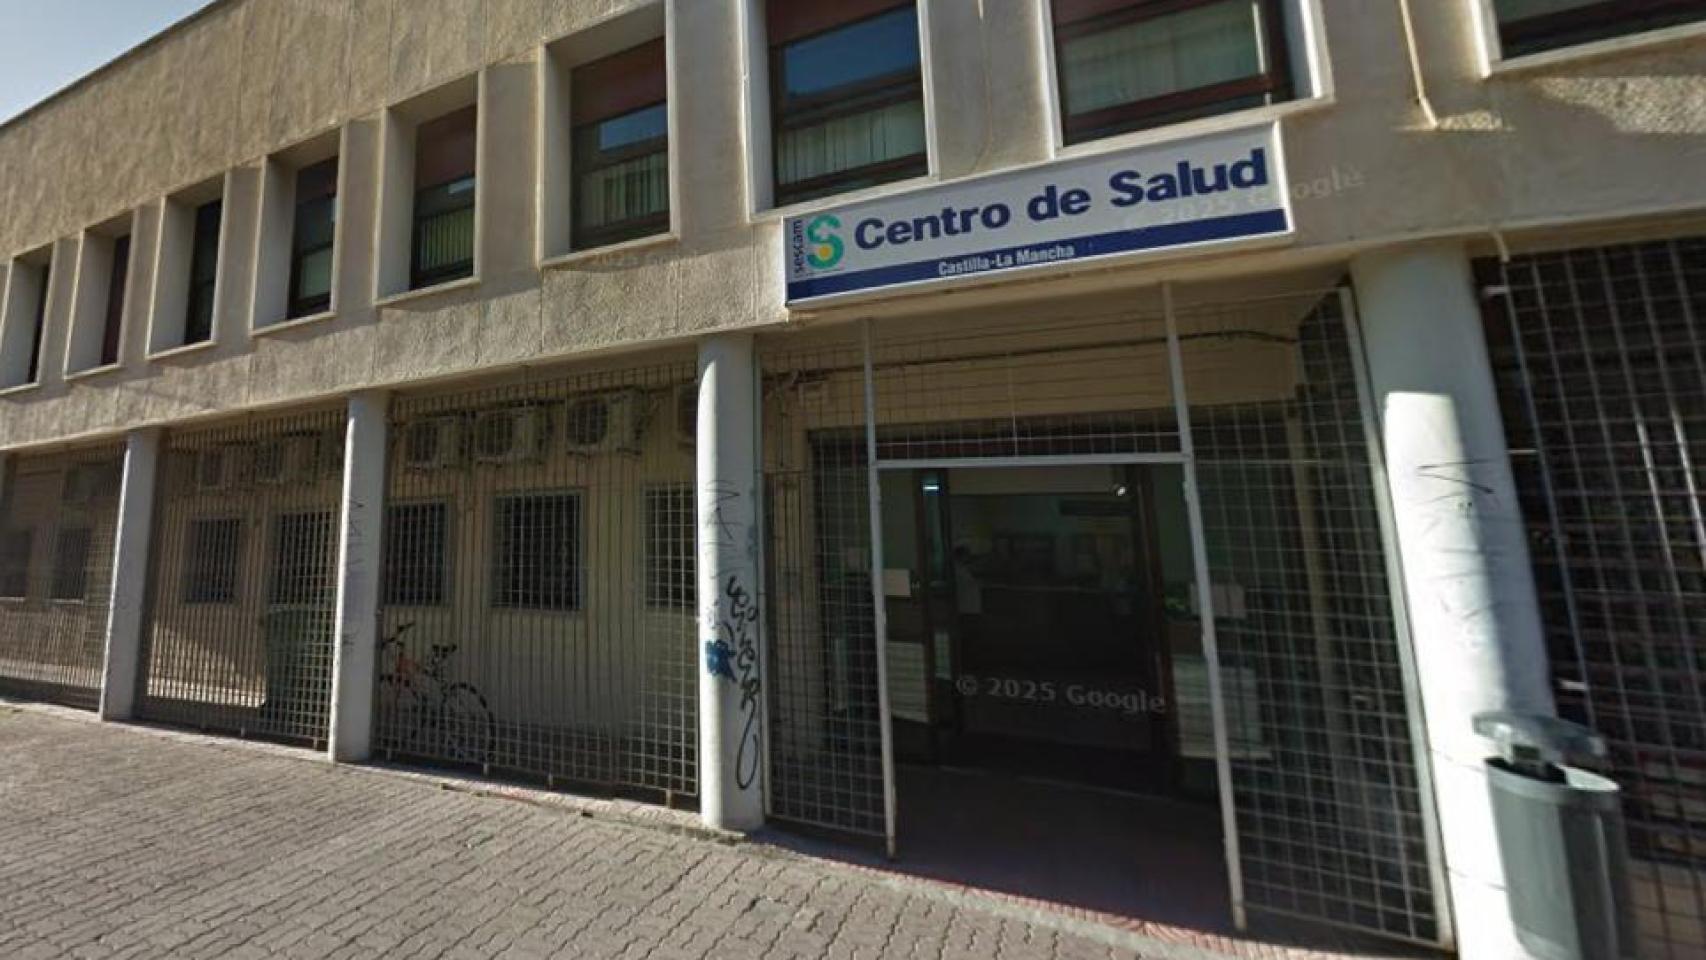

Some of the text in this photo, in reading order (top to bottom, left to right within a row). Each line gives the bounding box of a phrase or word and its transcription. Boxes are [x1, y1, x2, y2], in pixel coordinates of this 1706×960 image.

[854, 203, 1010, 250] Centro
[1027, 184, 1091, 222] de
[1109, 148, 1268, 207] Salud
[793, 220, 805, 274] sescam
[938, 245, 1074, 275] Castilla-La Mancha
